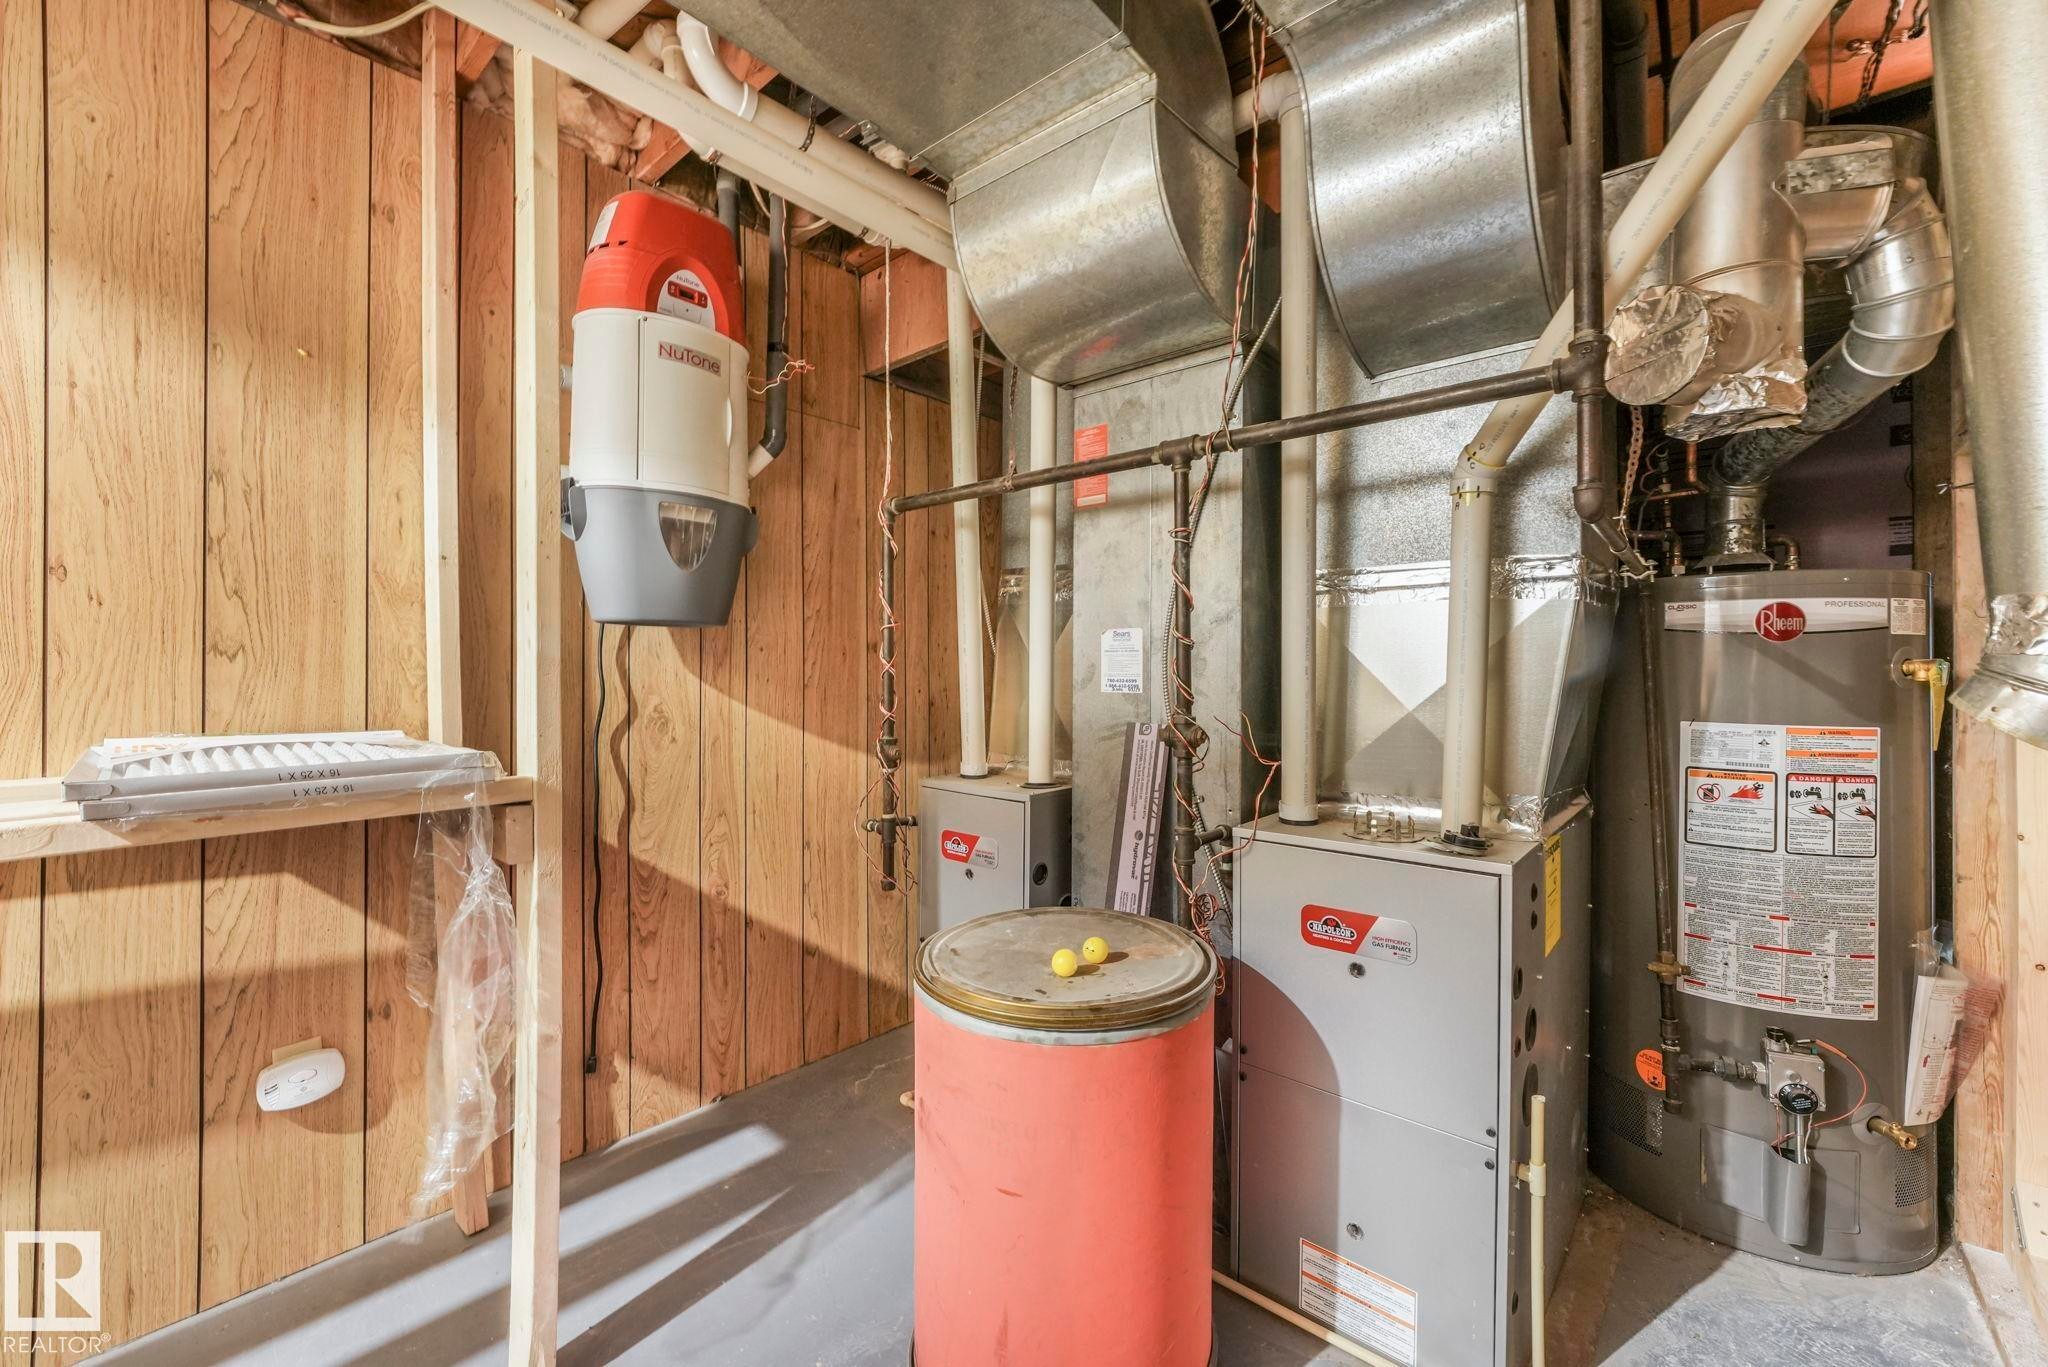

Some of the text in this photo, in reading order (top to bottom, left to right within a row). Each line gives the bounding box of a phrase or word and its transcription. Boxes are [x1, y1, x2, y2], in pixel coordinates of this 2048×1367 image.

[659, 343, 720, 374] NuTone
[1667, 603, 1697, 611] CLASSIC
[1824, 600, 1886, 609] PROFESSIONAL
[1760, 603, 1804, 636] Rheem
[288, 772, 296, 781] X
[300, 770, 314, 780] 25
[317, 769, 325, 778] X
[329, 769, 341, 777] 16
[302, 788, 311, 797] X
[314, 786, 328, 795] 25
[331, 785, 339, 794] X
[342, 784, 354, 792] 16
[1312, 922, 1351, 938] NAPOLEON
[1385, 943, 1412, 953] FURNACE
